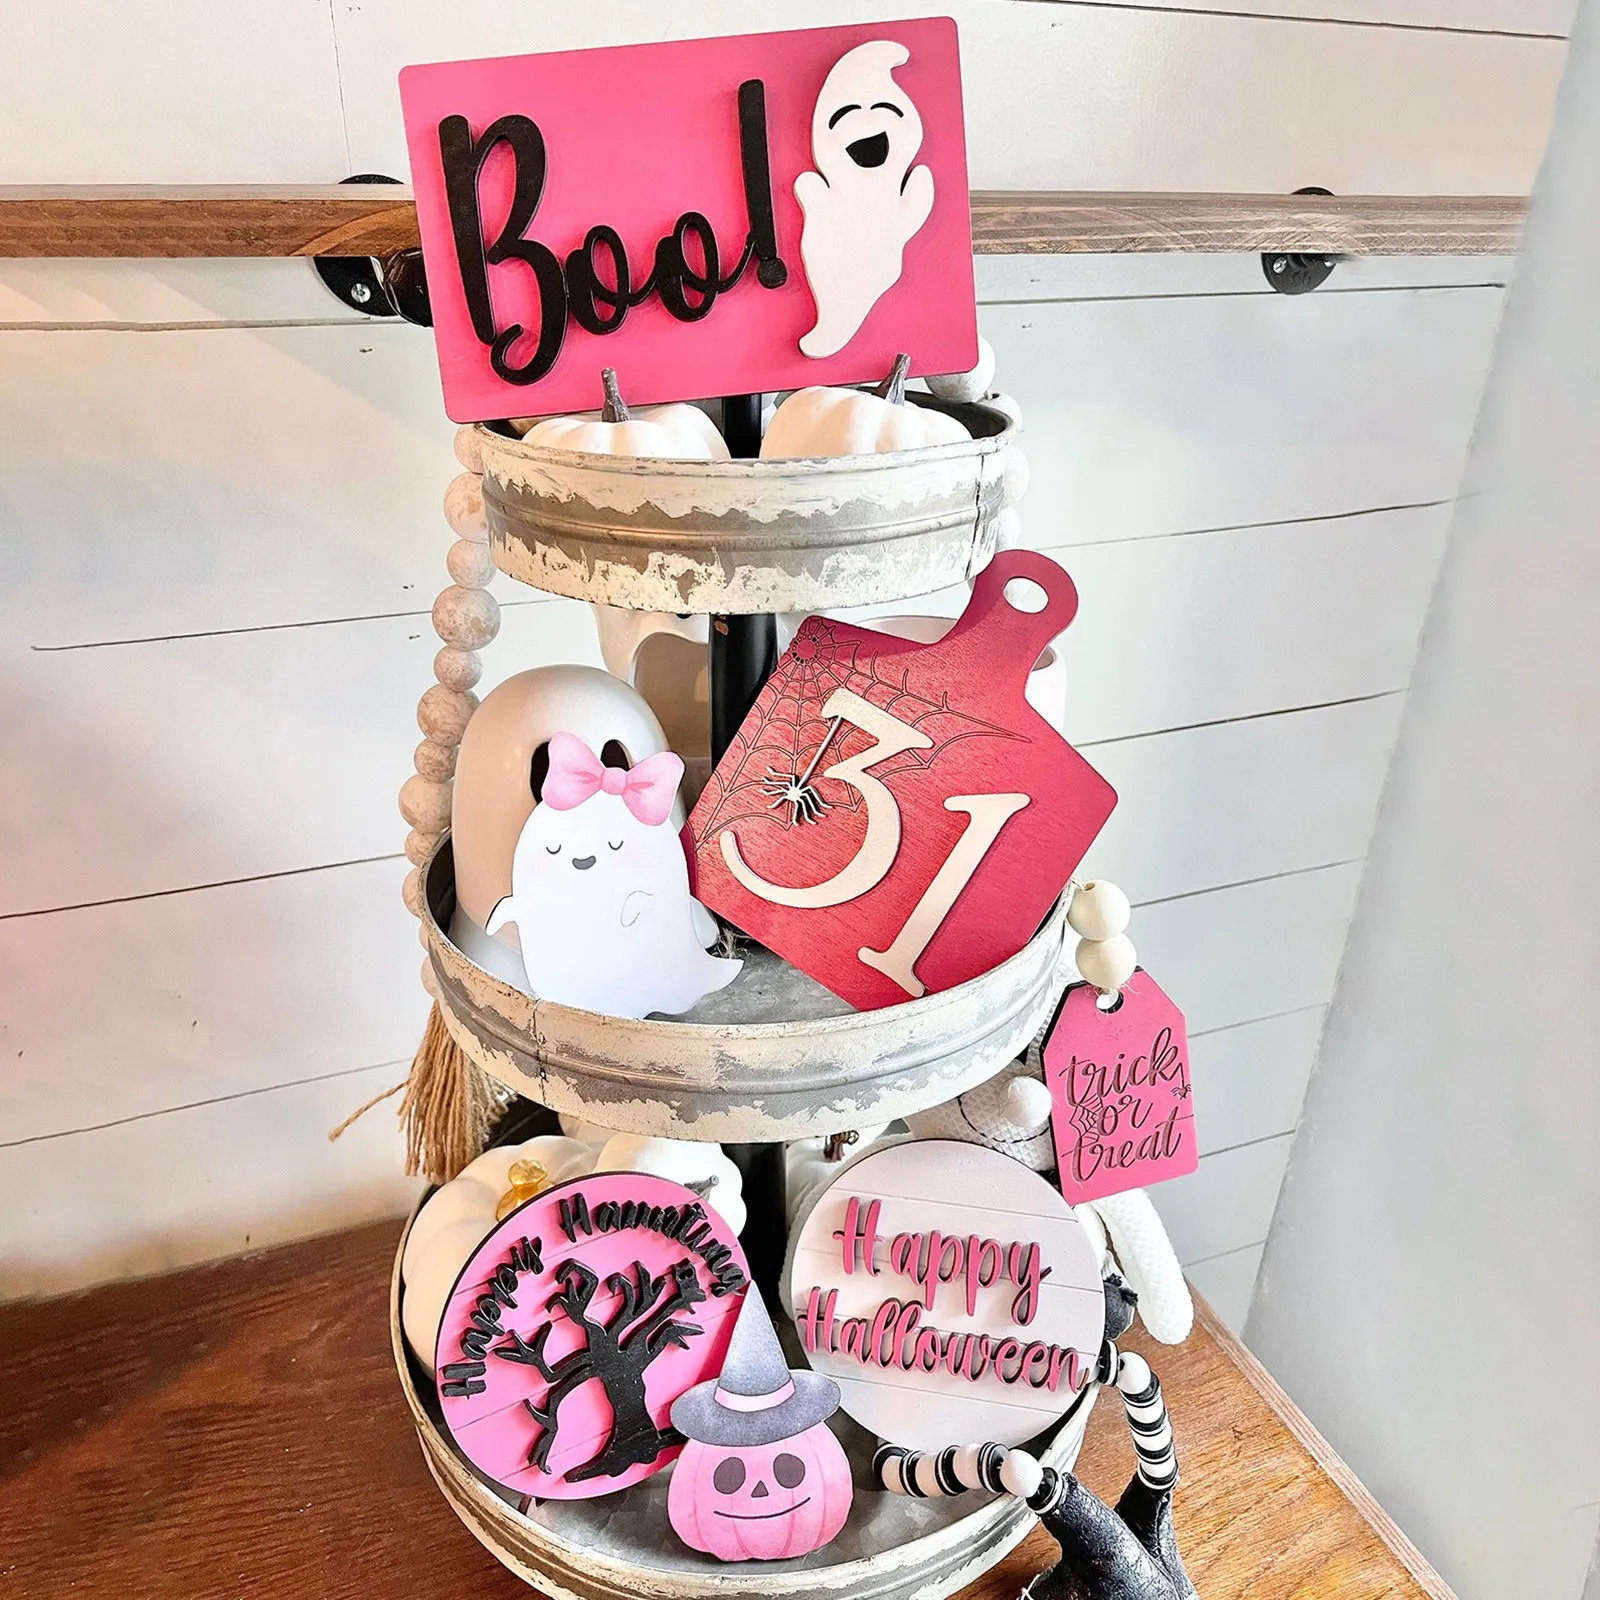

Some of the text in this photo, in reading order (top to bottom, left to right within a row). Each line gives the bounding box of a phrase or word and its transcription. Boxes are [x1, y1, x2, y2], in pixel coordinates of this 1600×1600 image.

[438, 78, 788, 386] Boo!
[719, 687, 1032, 998] 31
[1059, 1026, 1183, 1107] trick
[1098, 1094, 1154, 1137] or
[1060, 1105, 1194, 1182] treat
[441, 1191, 747, 1400] Happy Haunting
[831, 1195, 1053, 1327] Happy
[796, 1286, 1090, 1395] Halloween
